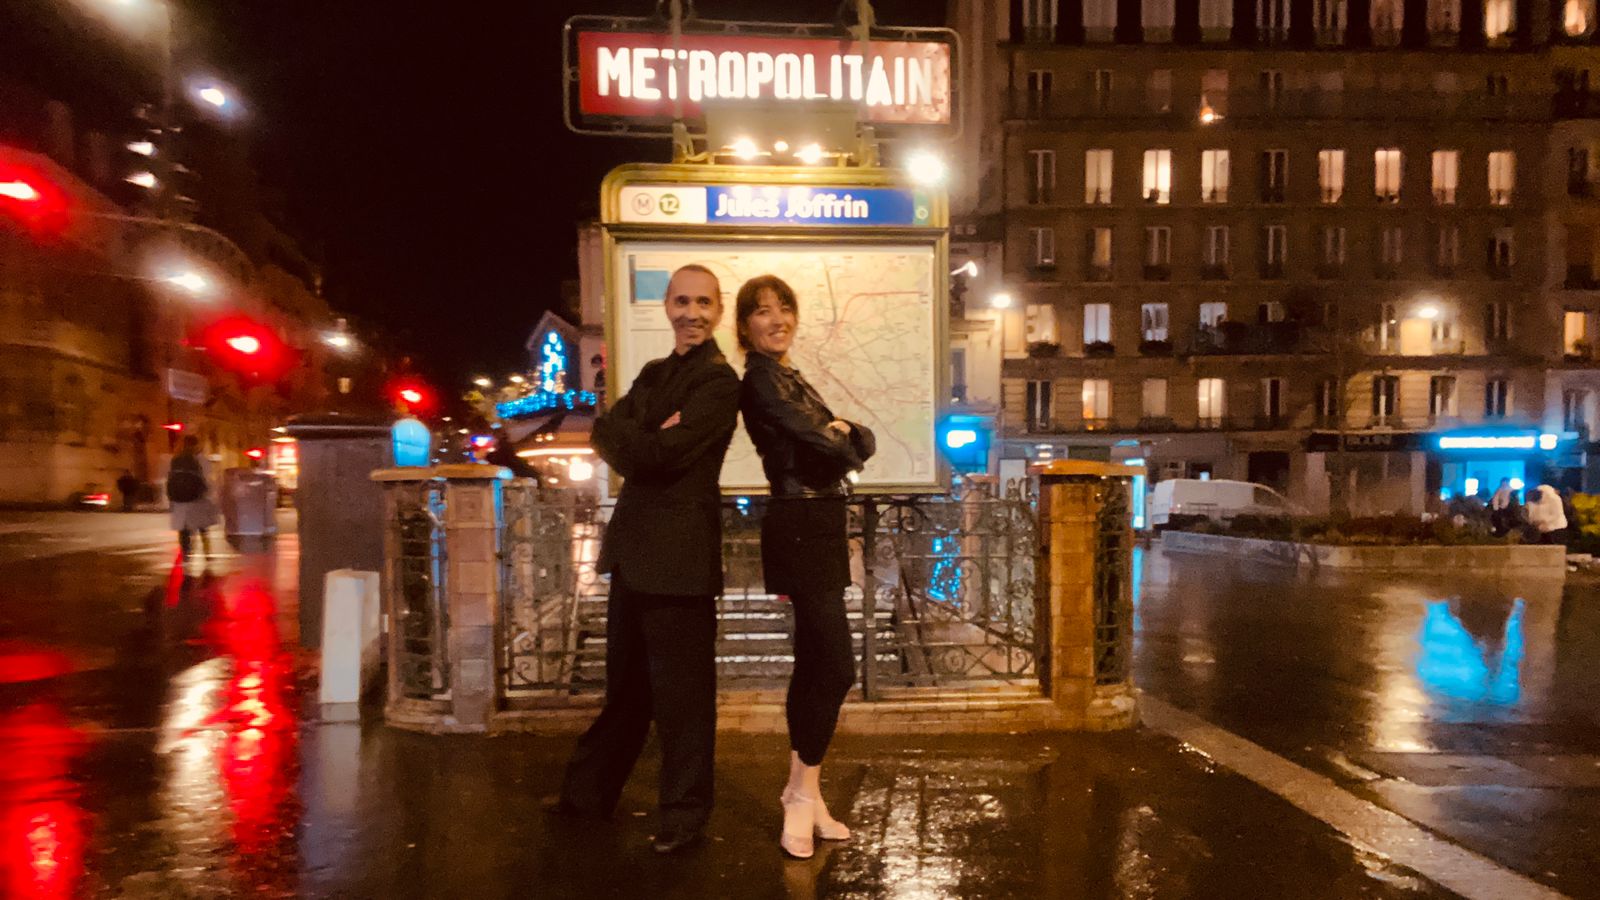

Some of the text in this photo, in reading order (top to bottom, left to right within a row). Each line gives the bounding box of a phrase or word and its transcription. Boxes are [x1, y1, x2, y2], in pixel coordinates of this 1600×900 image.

[597, 46, 932, 106] METROPOLITAIN
[661, 196, 680, 213] 12
[715, 192, 780, 218] Jules
[784, 192, 869, 218] Joffrin
